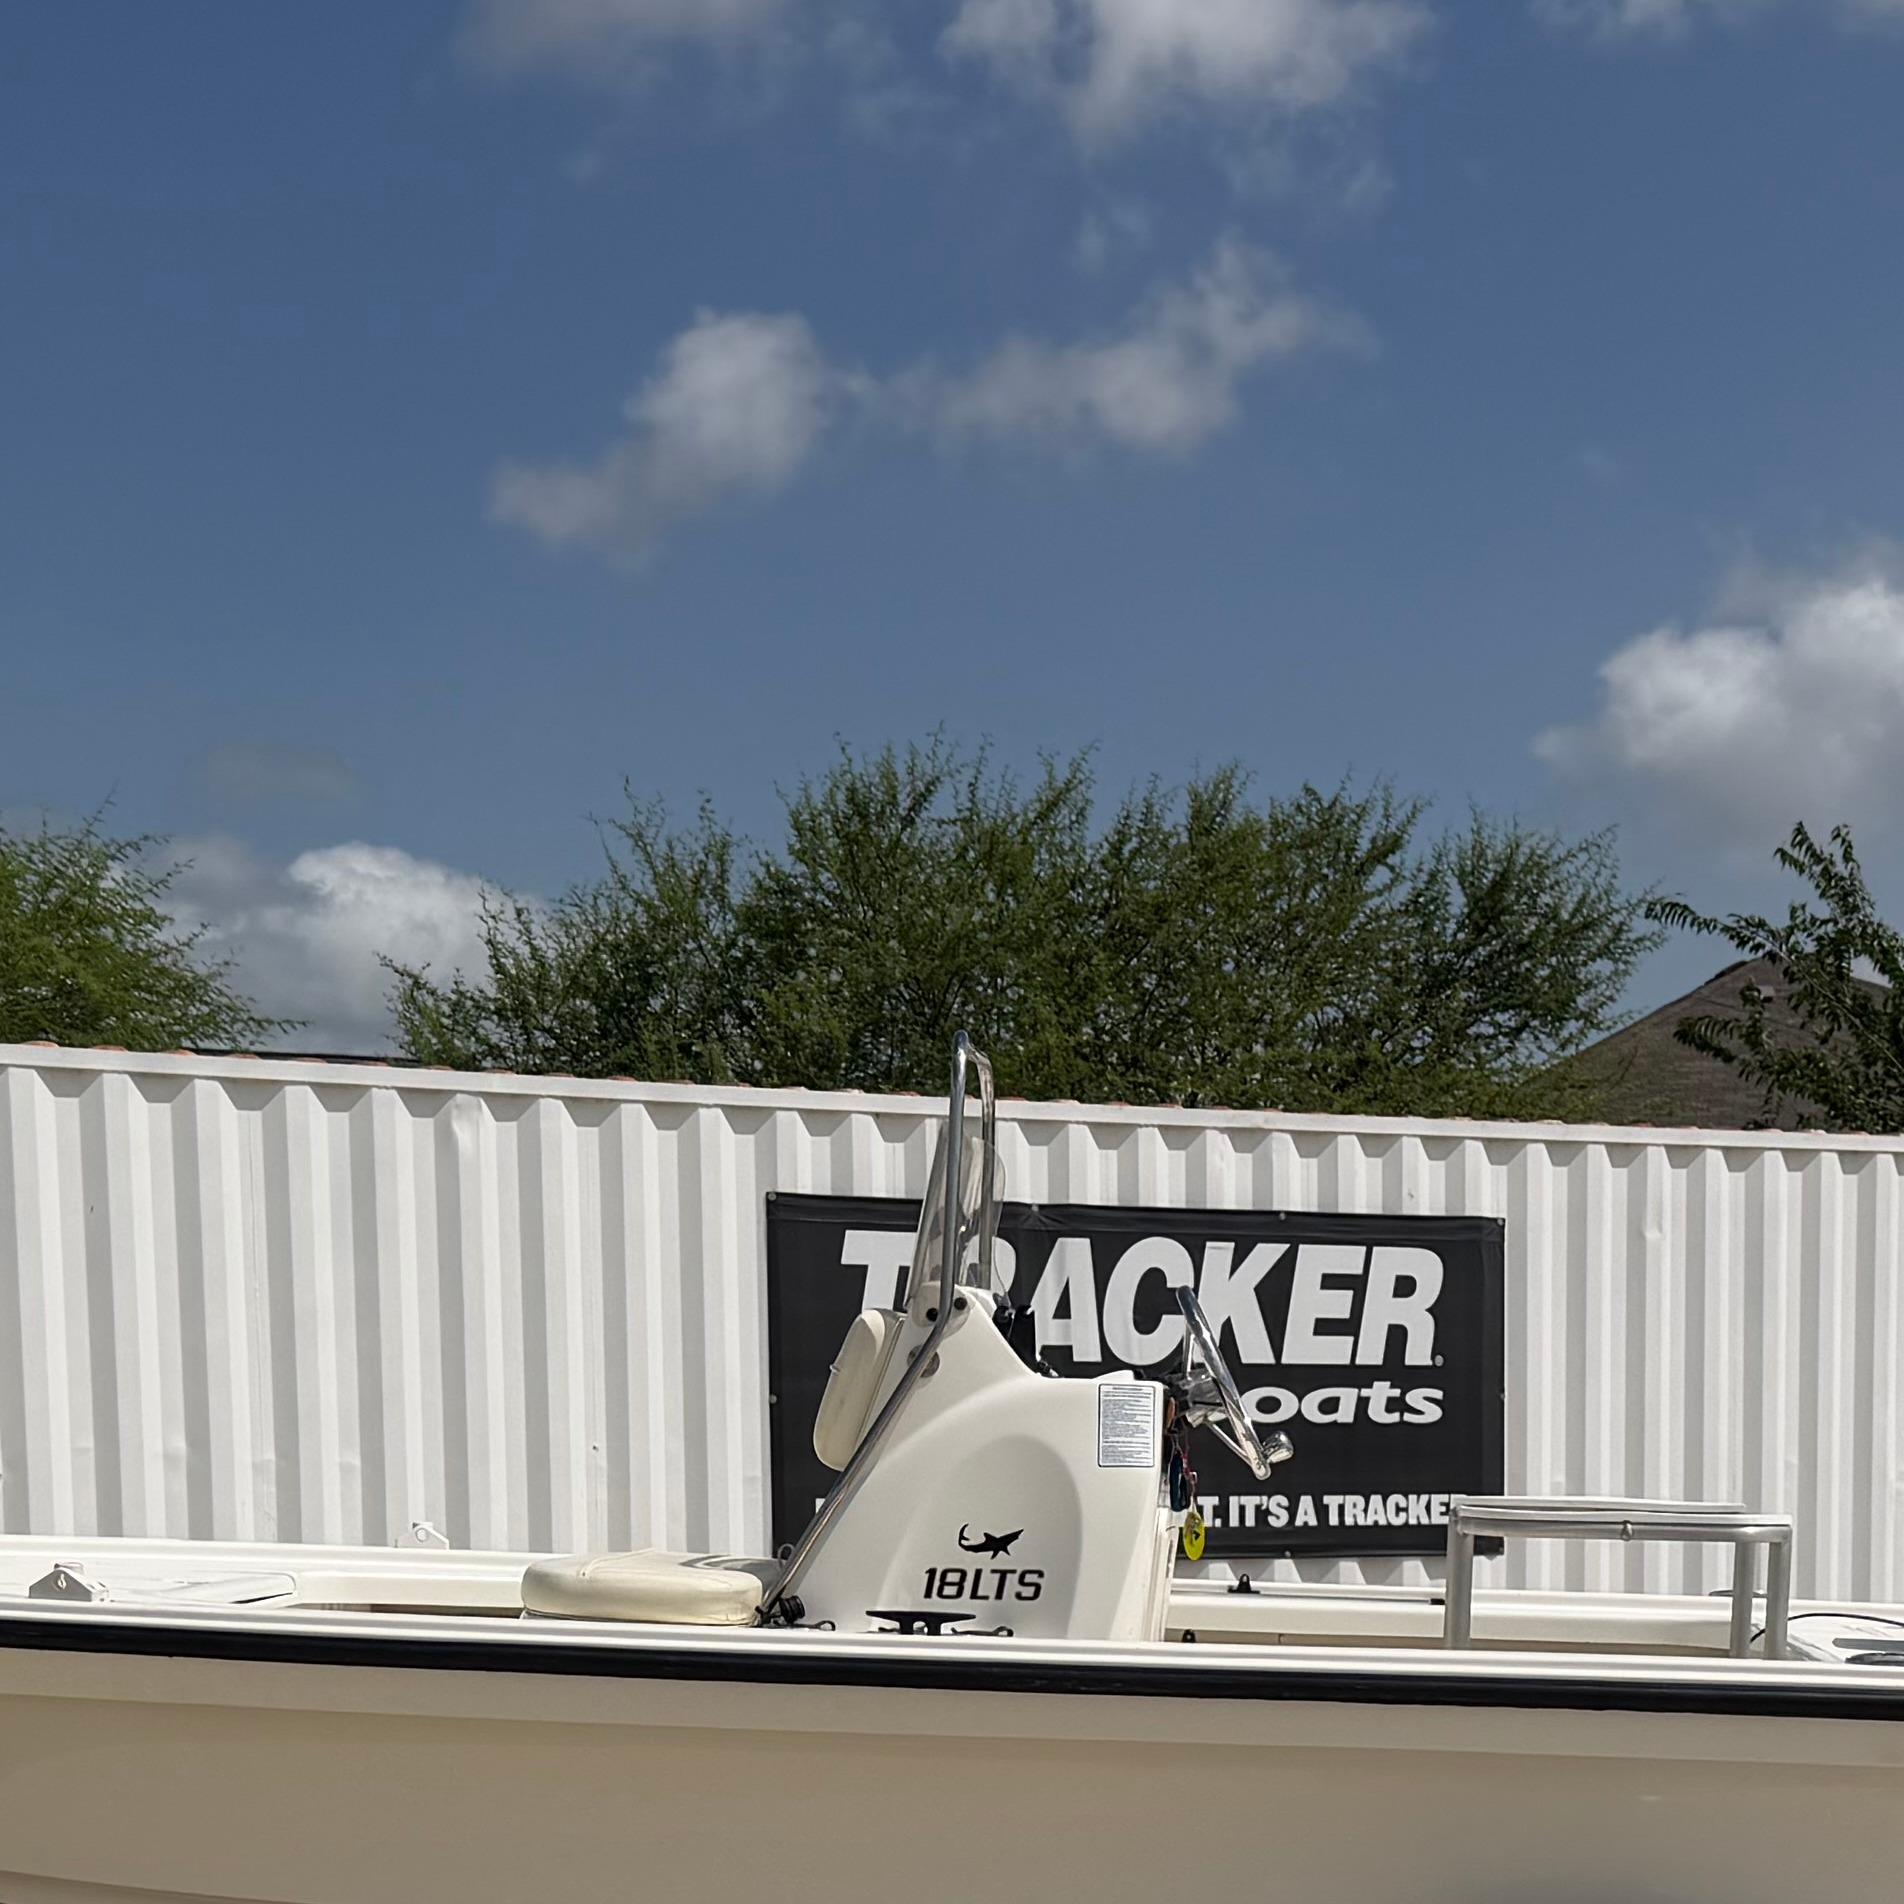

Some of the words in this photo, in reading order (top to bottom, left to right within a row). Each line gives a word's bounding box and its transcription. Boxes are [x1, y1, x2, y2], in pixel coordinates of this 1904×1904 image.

[1204, 1380, 1444, 1425] oats
[1228, 1495, 1290, 1528] IT'S
[1294, 1495, 1319, 1527] A
[1322, 1493, 1466, 1527] TRACKE
[923, 1567, 1045, 1601] 18LTS
